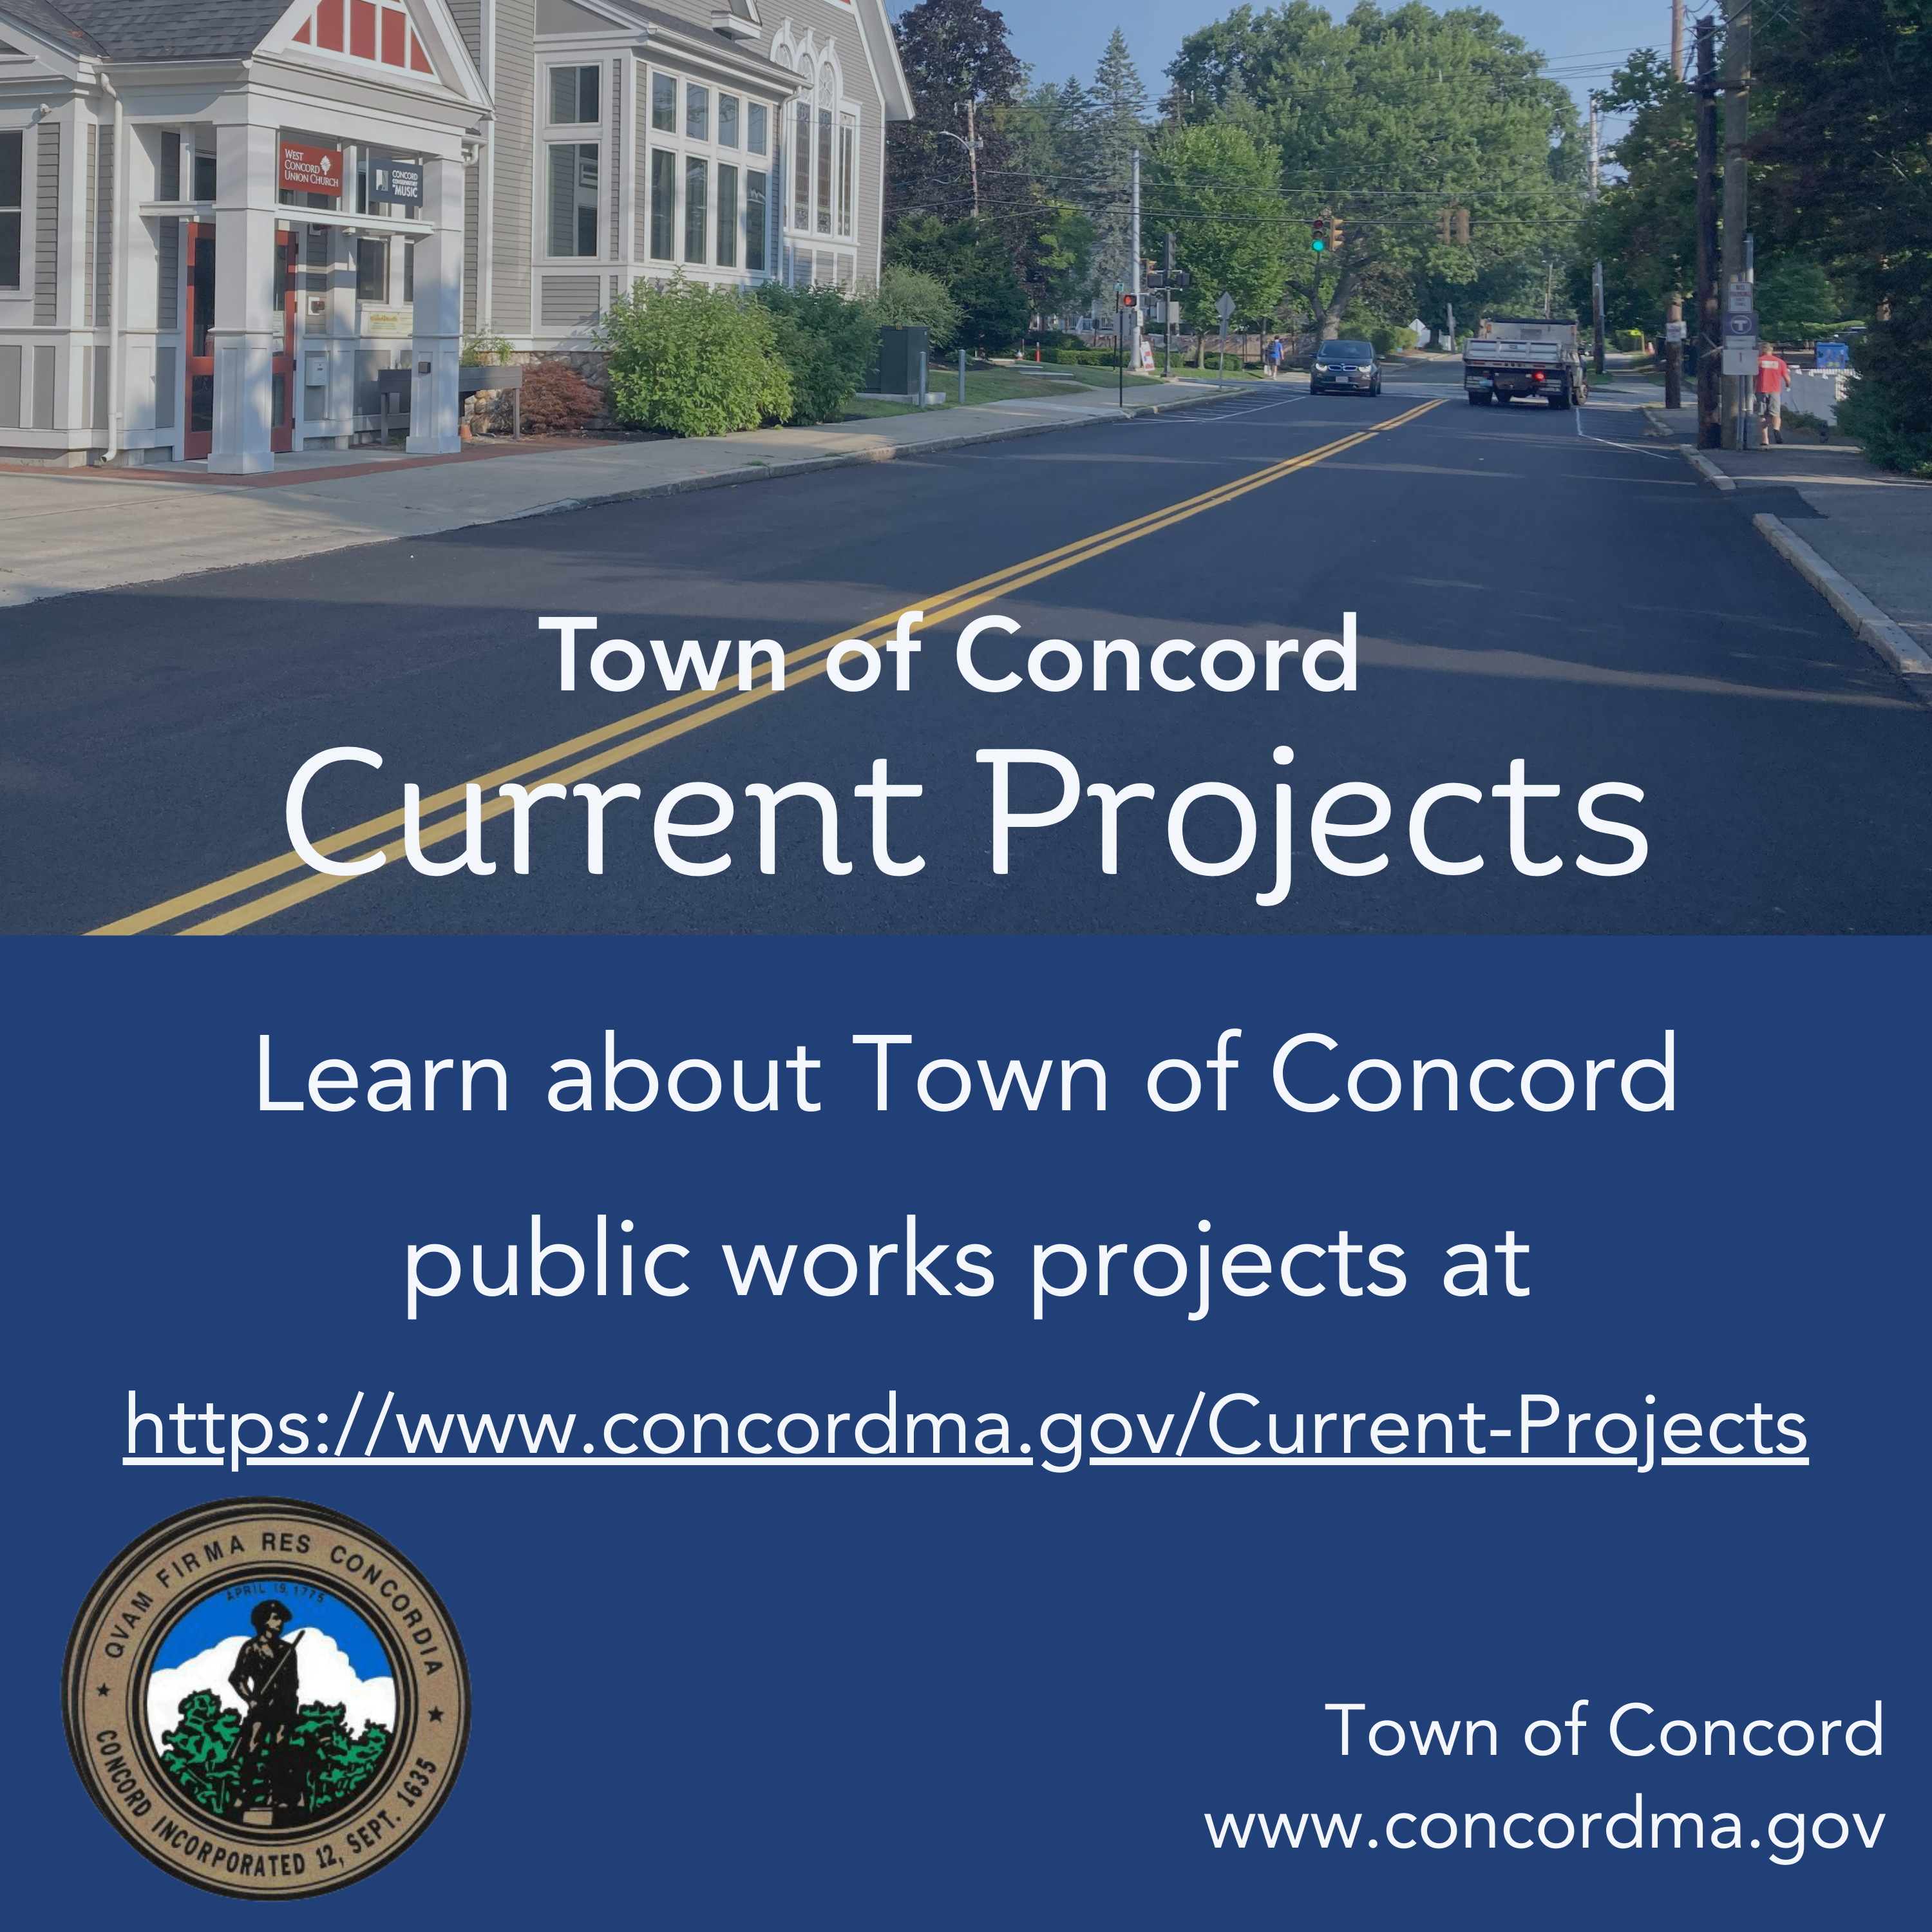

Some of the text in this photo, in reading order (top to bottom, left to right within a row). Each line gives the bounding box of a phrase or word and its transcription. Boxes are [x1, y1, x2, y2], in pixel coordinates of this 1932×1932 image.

[285, 149, 303, 161] WEST
[285, 159, 320, 174] CONCORD
[285, 170, 339, 187] UNION CHURCH
[392, 170, 418, 180] CONCORD
[395, 185, 418, 198] MUSIC
